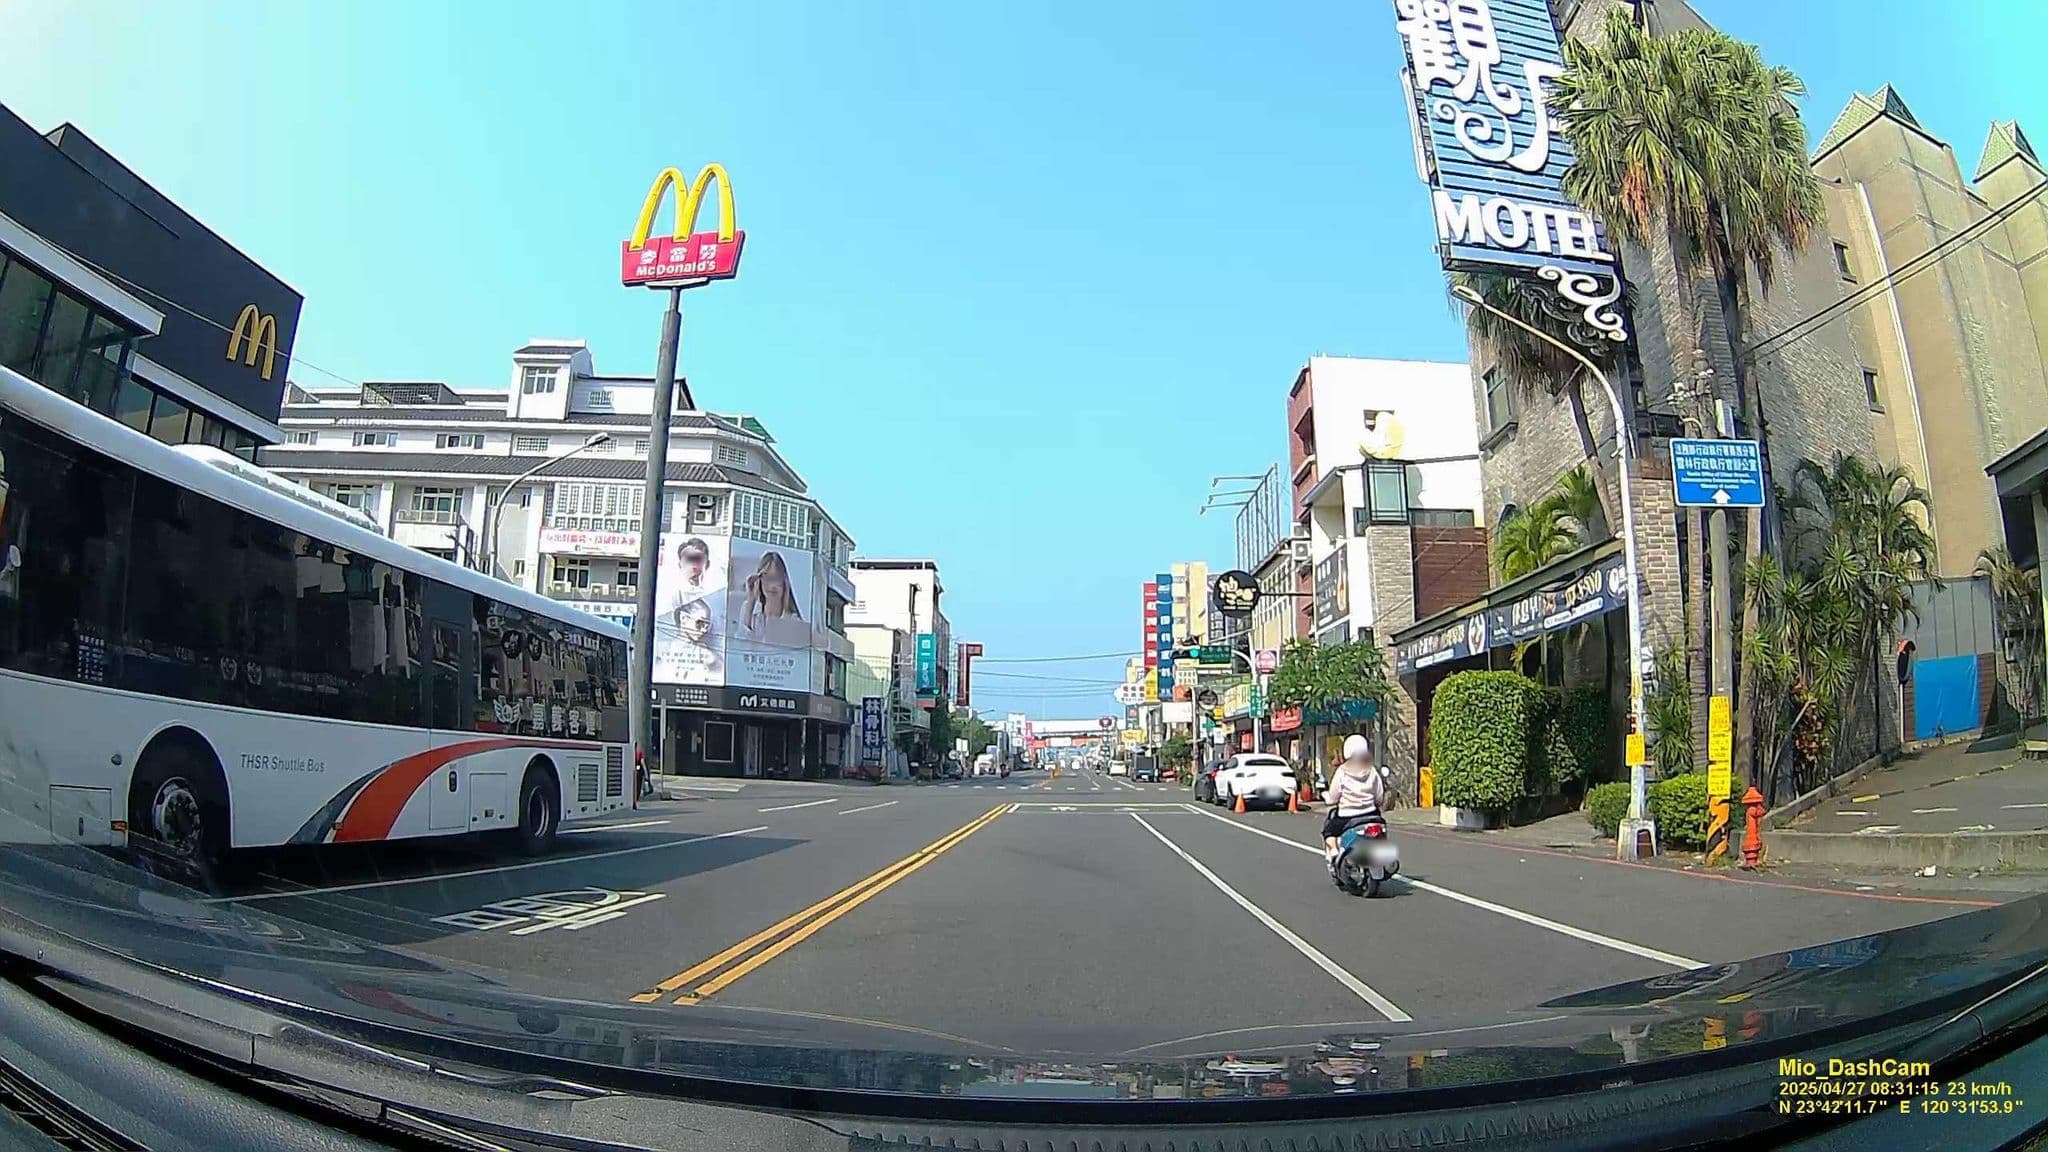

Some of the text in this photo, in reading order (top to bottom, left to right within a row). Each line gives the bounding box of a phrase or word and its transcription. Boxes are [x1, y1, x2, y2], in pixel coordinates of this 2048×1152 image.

[1434, 191, 1615, 261] MOTEL
[636, 261, 716, 276] McDonald's
[240, 753, 325, 773] THSR Shuttle Bus
